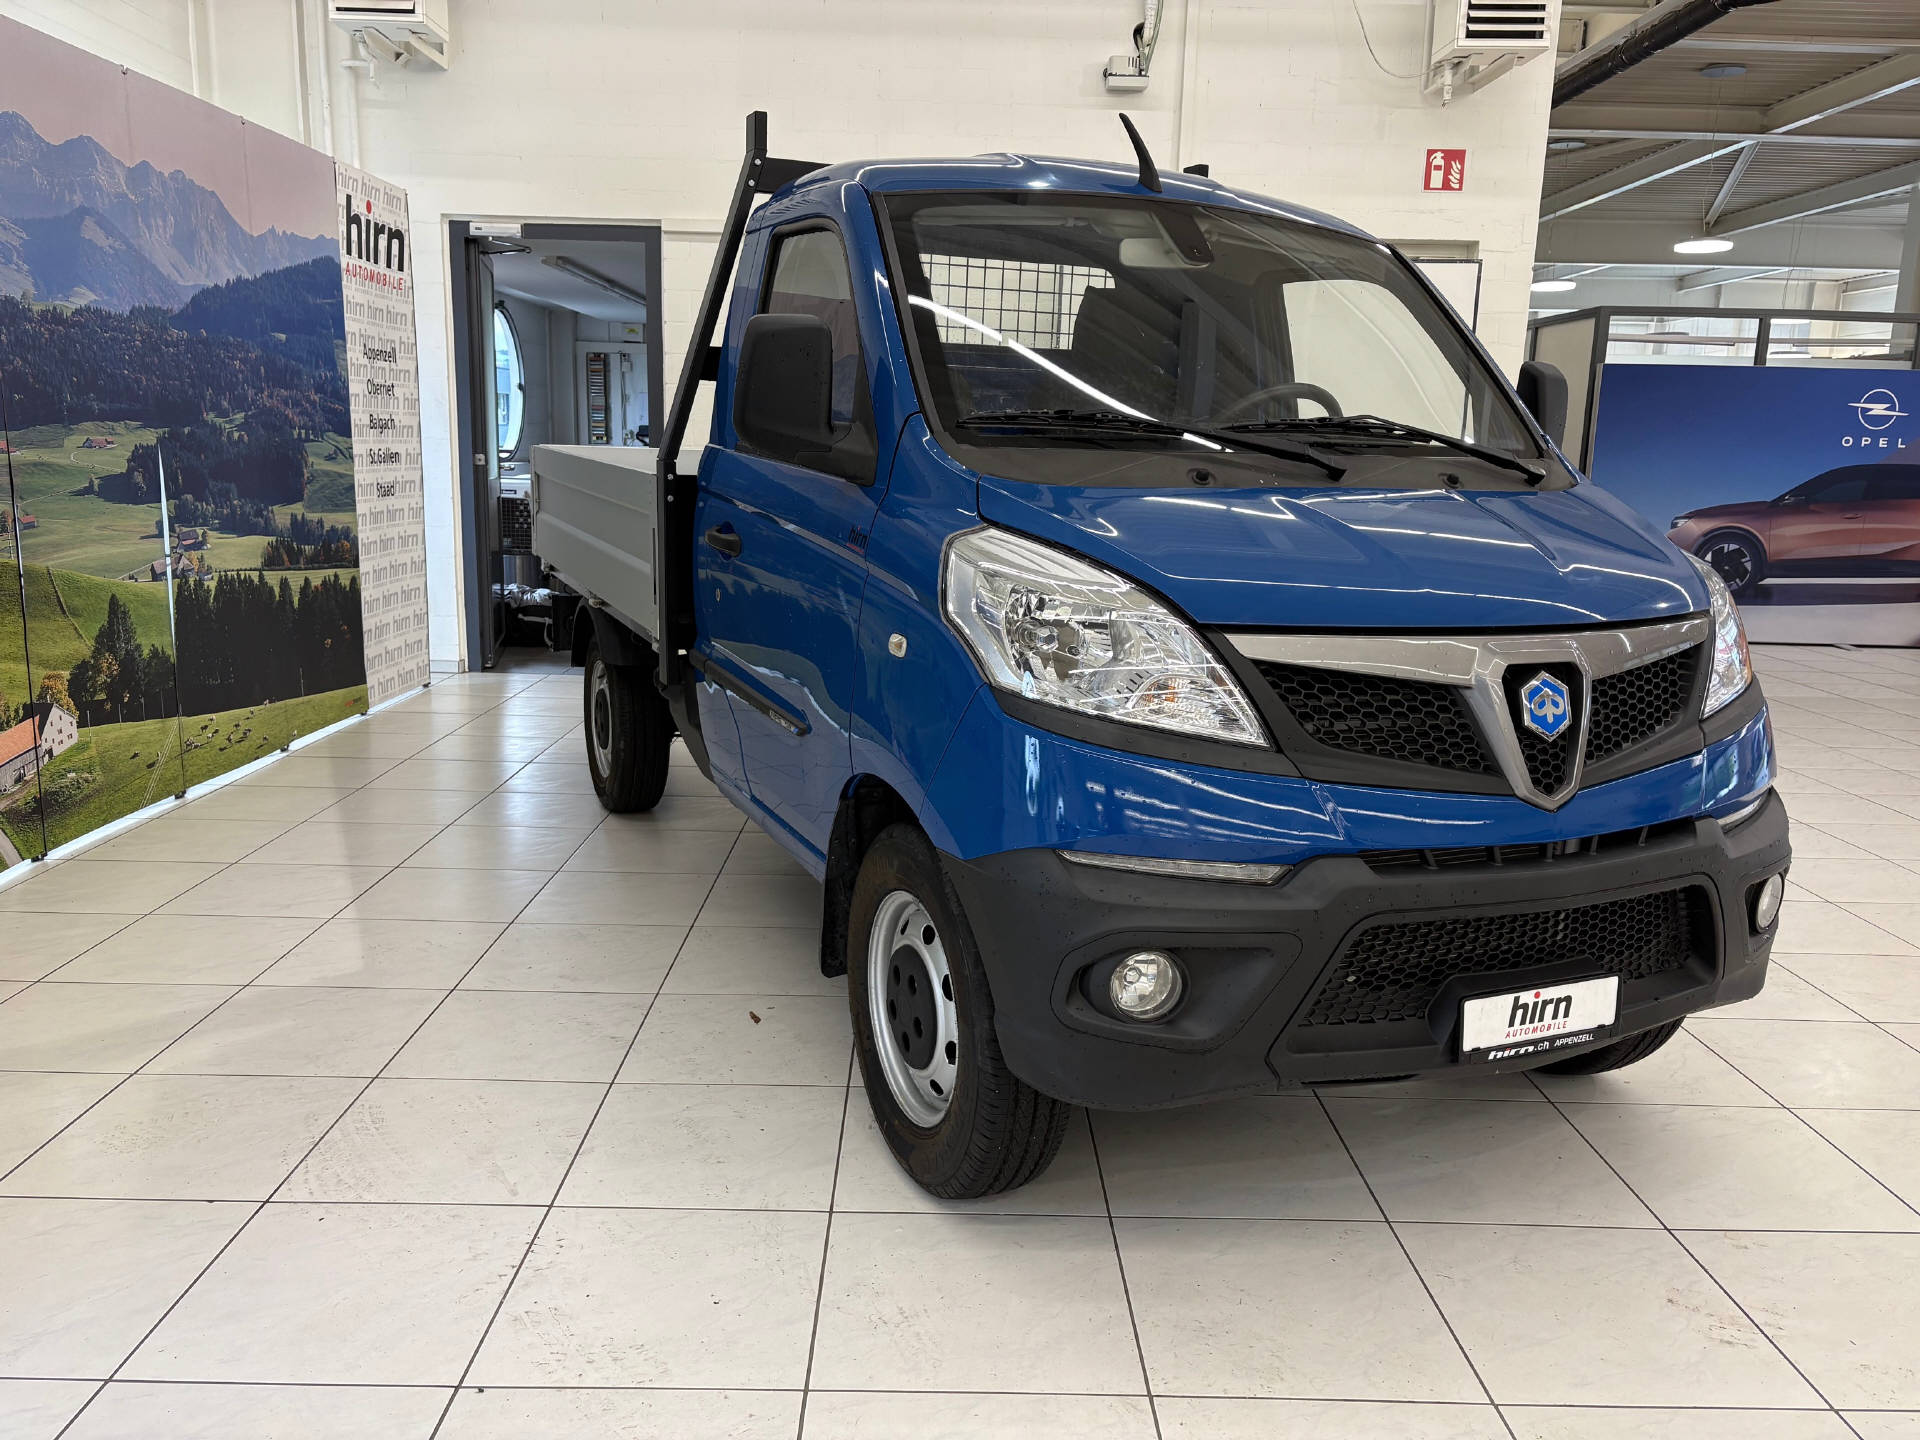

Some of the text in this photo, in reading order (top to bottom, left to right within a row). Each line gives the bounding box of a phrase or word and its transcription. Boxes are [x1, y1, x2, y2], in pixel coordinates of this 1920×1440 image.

[338, 166, 402, 211] hirn hirn hirn
[346, 193, 404, 272] hirn
[345, 261, 403, 291] AUTOMOBILE
[346, 295, 365, 318] hirn
[367, 299, 384, 322] hirn
[387, 304, 407, 327] hirn
[363, 343, 397, 364] Appenzell
[399, 336, 416, 355] hir
[350, 356, 368, 378] hirn
[403, 393, 418, 410] hir
[369, 413, 395, 434] Balgach
[1841, 436, 1906, 448] OPEL
[405, 447, 421, 465] hir
[358, 478, 374, 497] hirn
[377, 480, 395, 498] Staad
[370, 506, 384, 526] hirn
[387, 504, 404, 523] hirn
[408, 501, 423, 520] hir
[361, 536, 377, 557] hirn
[380, 533, 395, 552] hirn
[398, 530, 418, 548] hirn
[373, 562, 387, 583] hirn
[389, 559, 407, 579] hirn
[411, 555, 425, 574] hir
[364, 594, 380, 615] hirn
[382, 588, 399, 609] hirn
[401, 584, 420, 601] hirn
[375, 620, 390, 640] hirn
[393, 614, 411, 633] hirn
[414, 608, 427, 627] hir
[366, 653, 382, 673] hirn
[385, 645, 402, 664] hirn
[405, 639, 422, 657] hirn
[378, 675, 395, 696] hirn
[397, 667, 415, 686] hirn
[417, 660, 429, 679] hir
[1507, 991, 1573, 1028] hirn
[1505, 1020, 1568, 1039] AUTOMOBILE
[1487, 1033, 1595, 1060] hirn.ch APPENZELL
